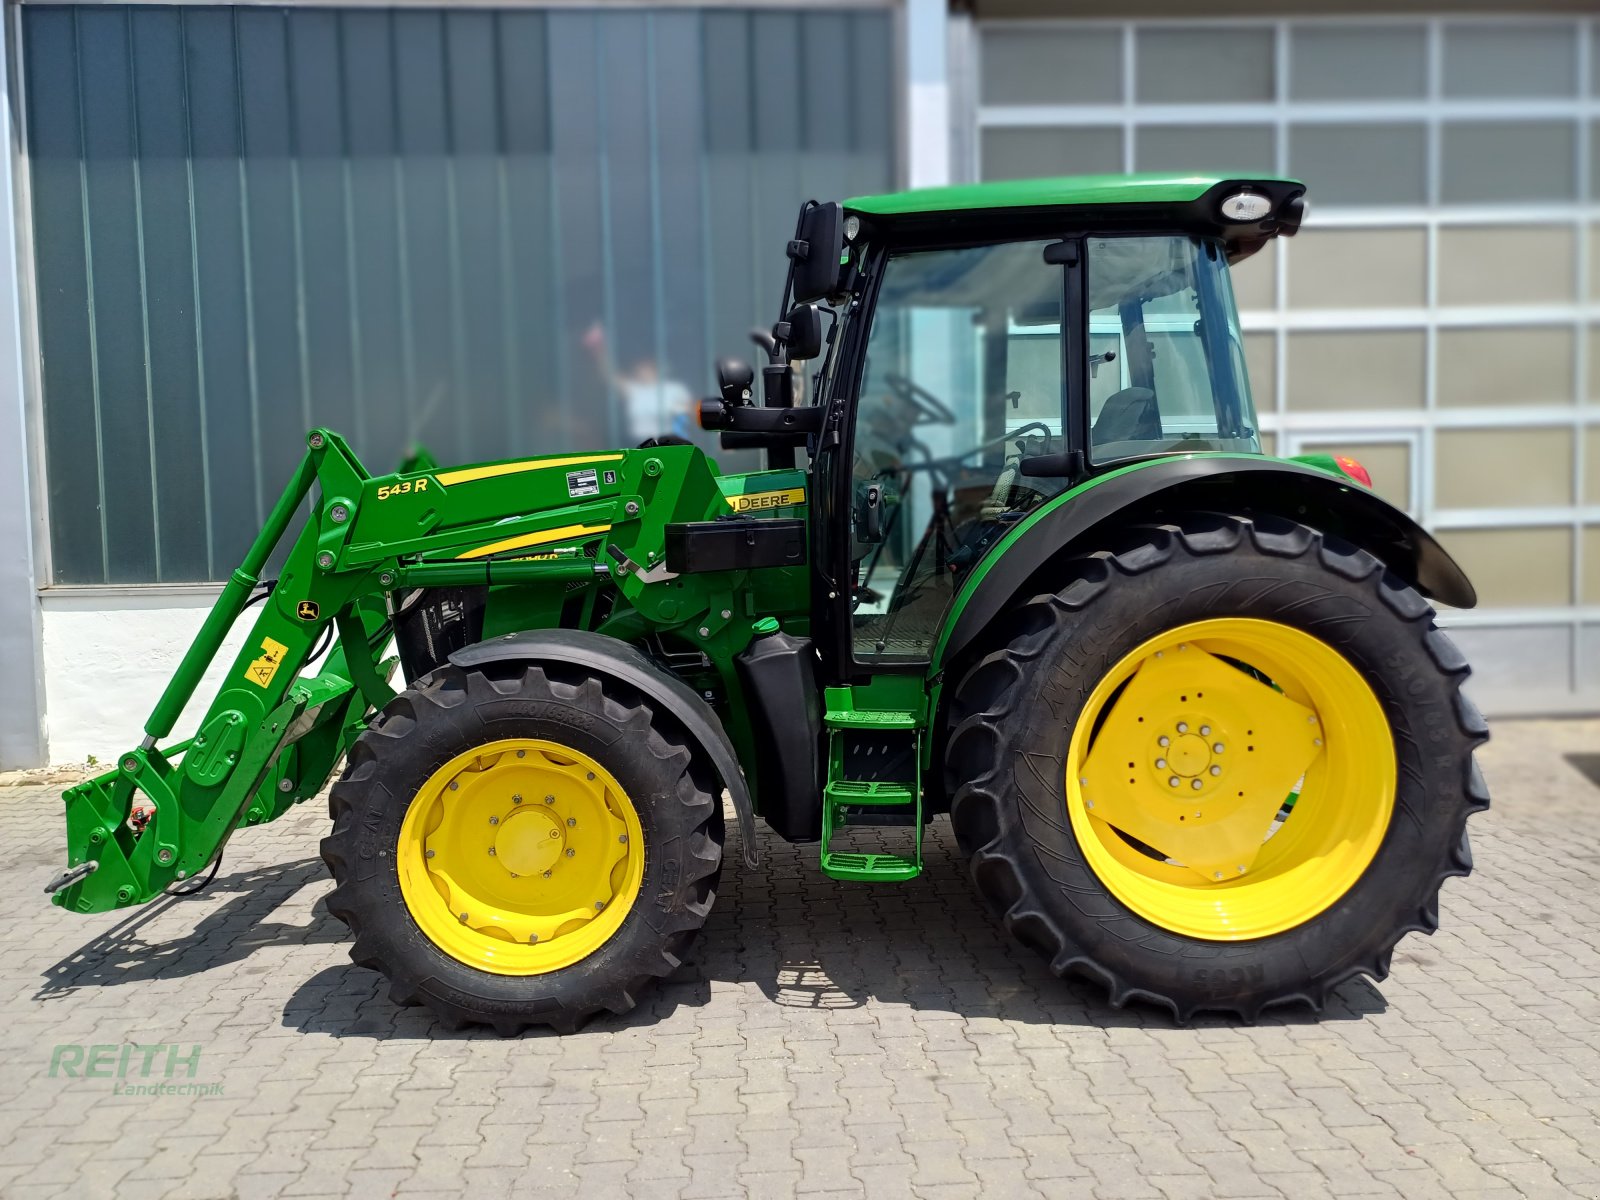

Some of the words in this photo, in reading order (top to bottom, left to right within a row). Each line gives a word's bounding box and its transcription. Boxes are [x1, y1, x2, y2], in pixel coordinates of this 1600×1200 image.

[377, 482, 411, 500] 543
[414, 478, 428, 493] R
[738, 494, 790, 510] DEERE
